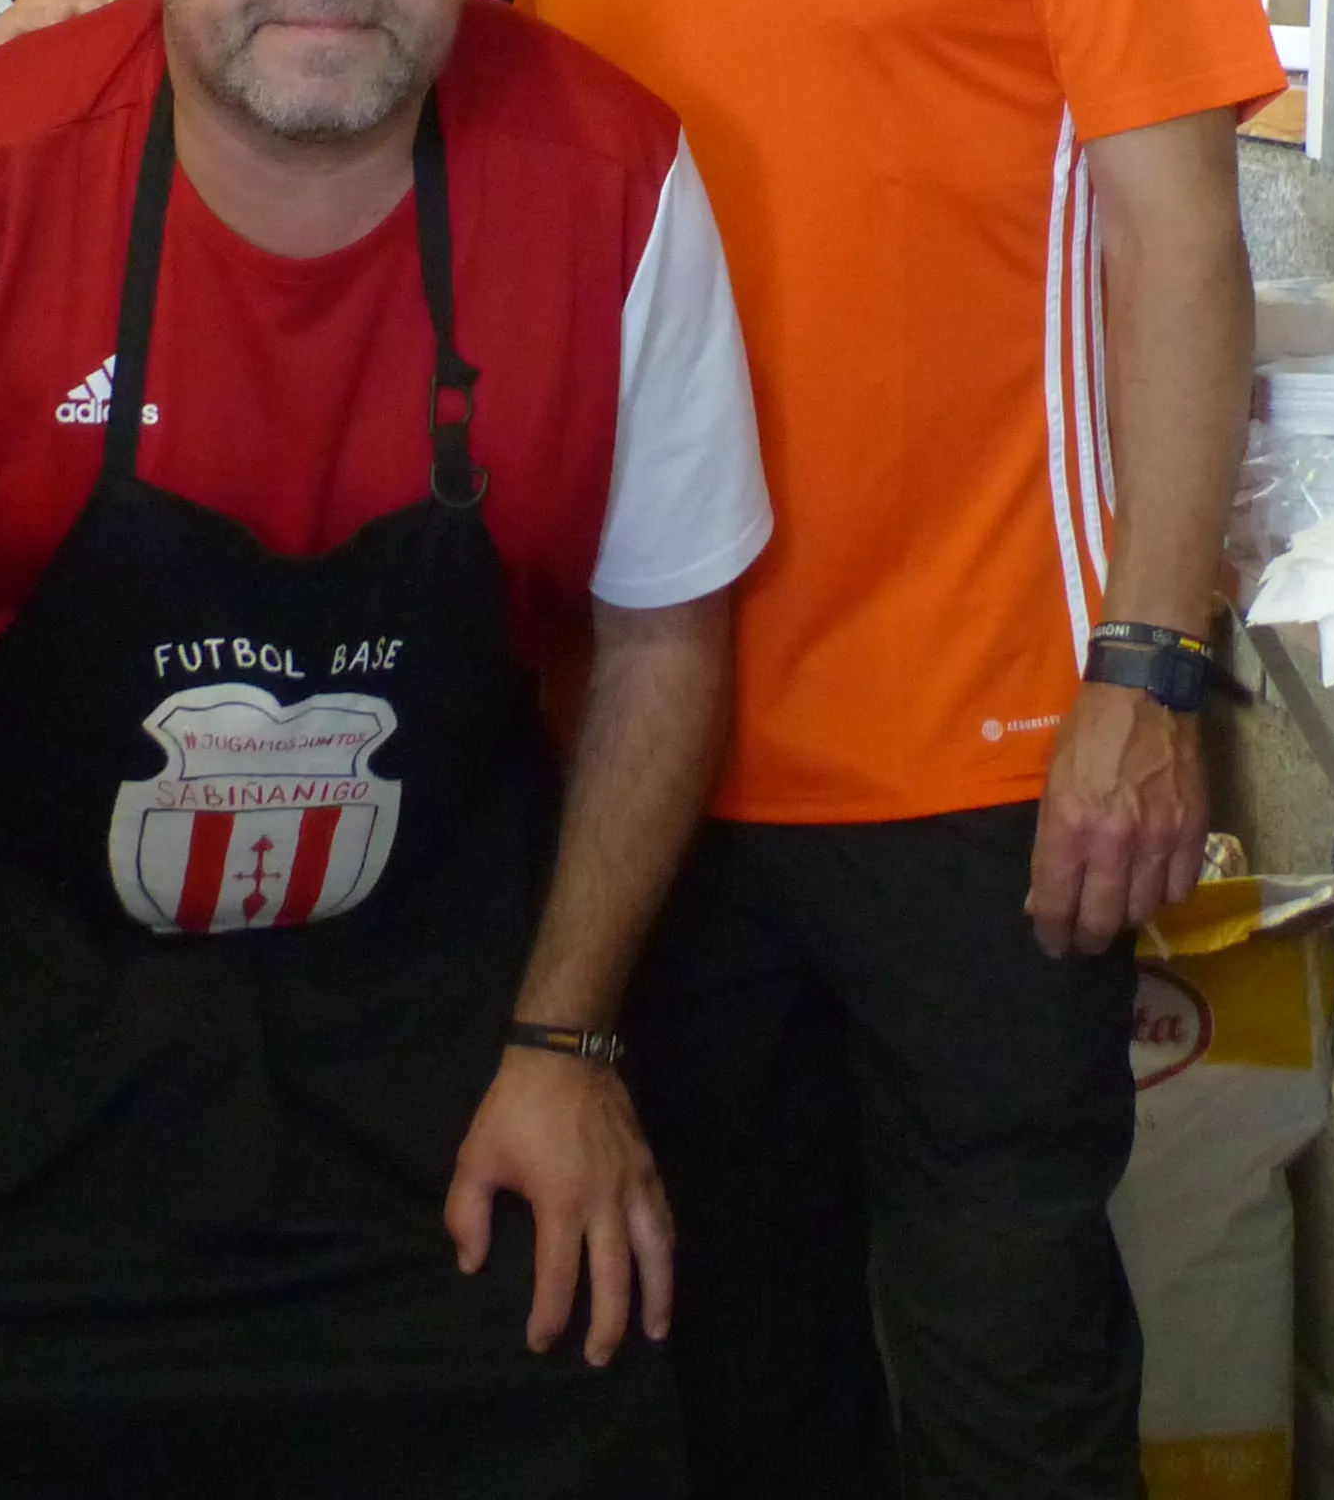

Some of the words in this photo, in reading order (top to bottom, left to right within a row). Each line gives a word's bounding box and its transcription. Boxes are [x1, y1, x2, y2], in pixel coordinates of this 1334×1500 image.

[55, 397, 159, 425] adis
[153, 636, 306, 678] FUTBOL
[330, 635, 404, 675] BASE
